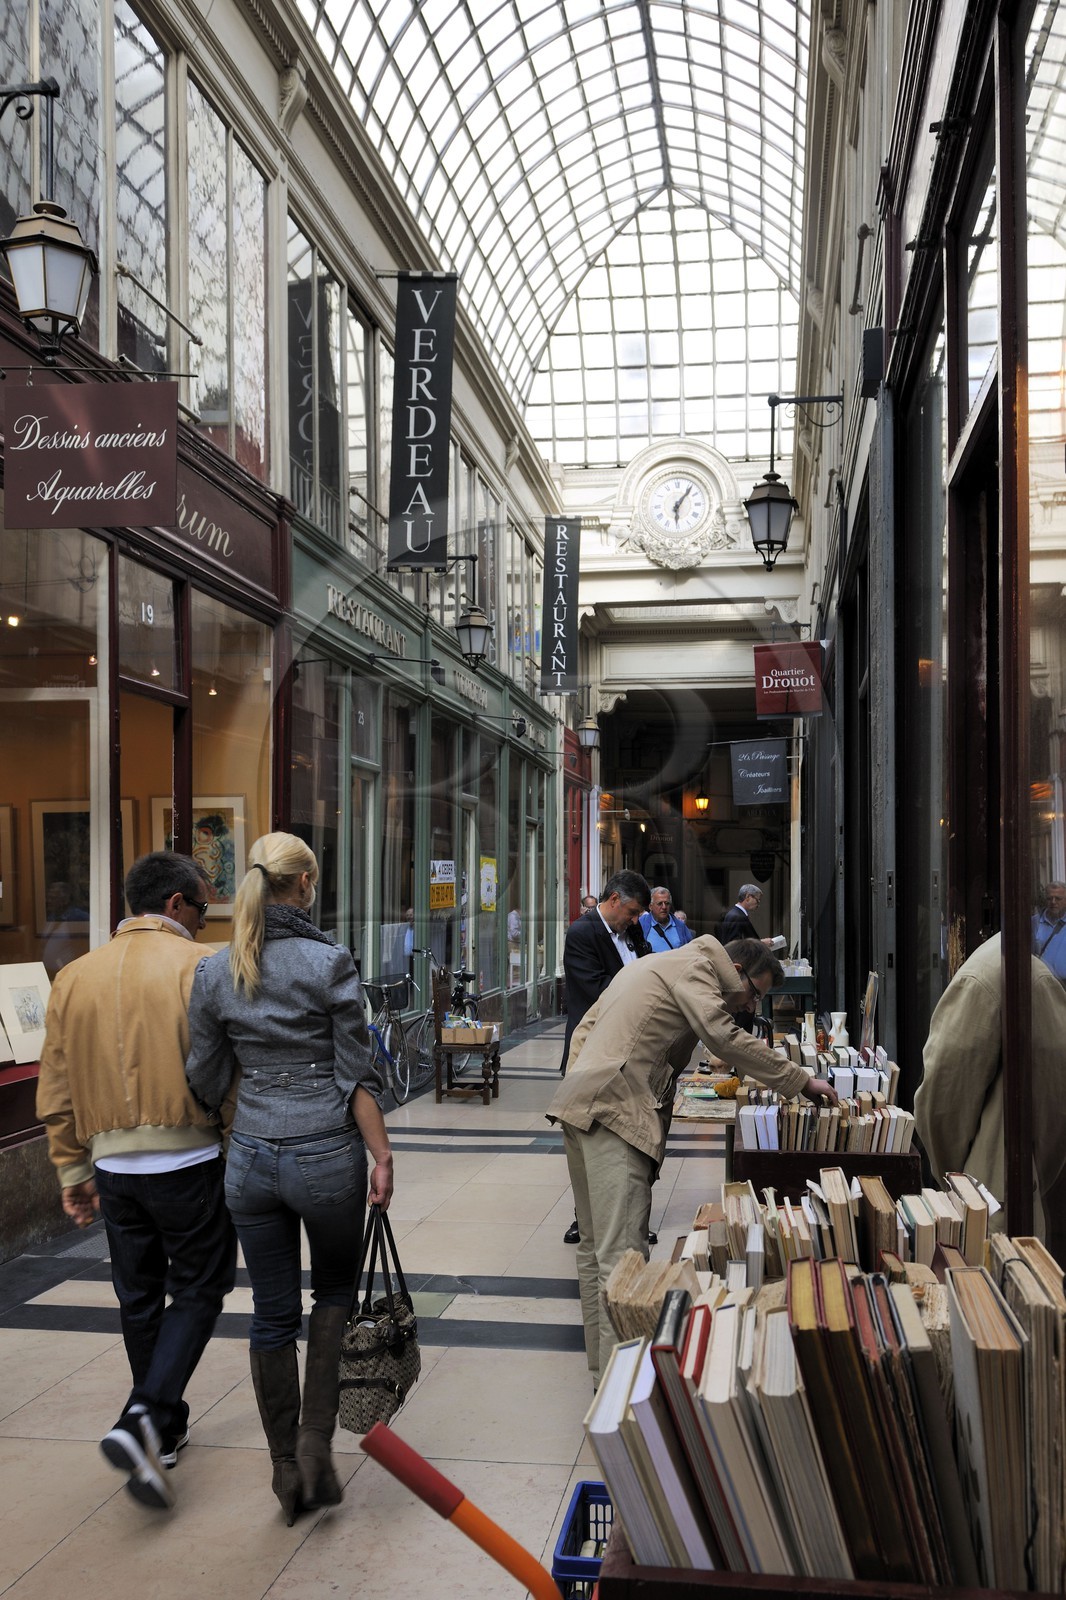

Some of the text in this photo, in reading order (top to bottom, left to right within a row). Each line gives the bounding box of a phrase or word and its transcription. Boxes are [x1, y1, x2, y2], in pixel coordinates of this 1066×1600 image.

[10, 414, 167, 450] Dessins anciens
[401, 289, 442, 553] VERDEAU
[26, 469, 157, 515] Aquarelles
[141, 602, 154, 625] 19
[326, 583, 406, 657] RESTAURANT
[550, 525, 570, 688] RESTAURANT
[761, 674, 816, 689] Drouot
[770, 667, 805, 678] Quartier
